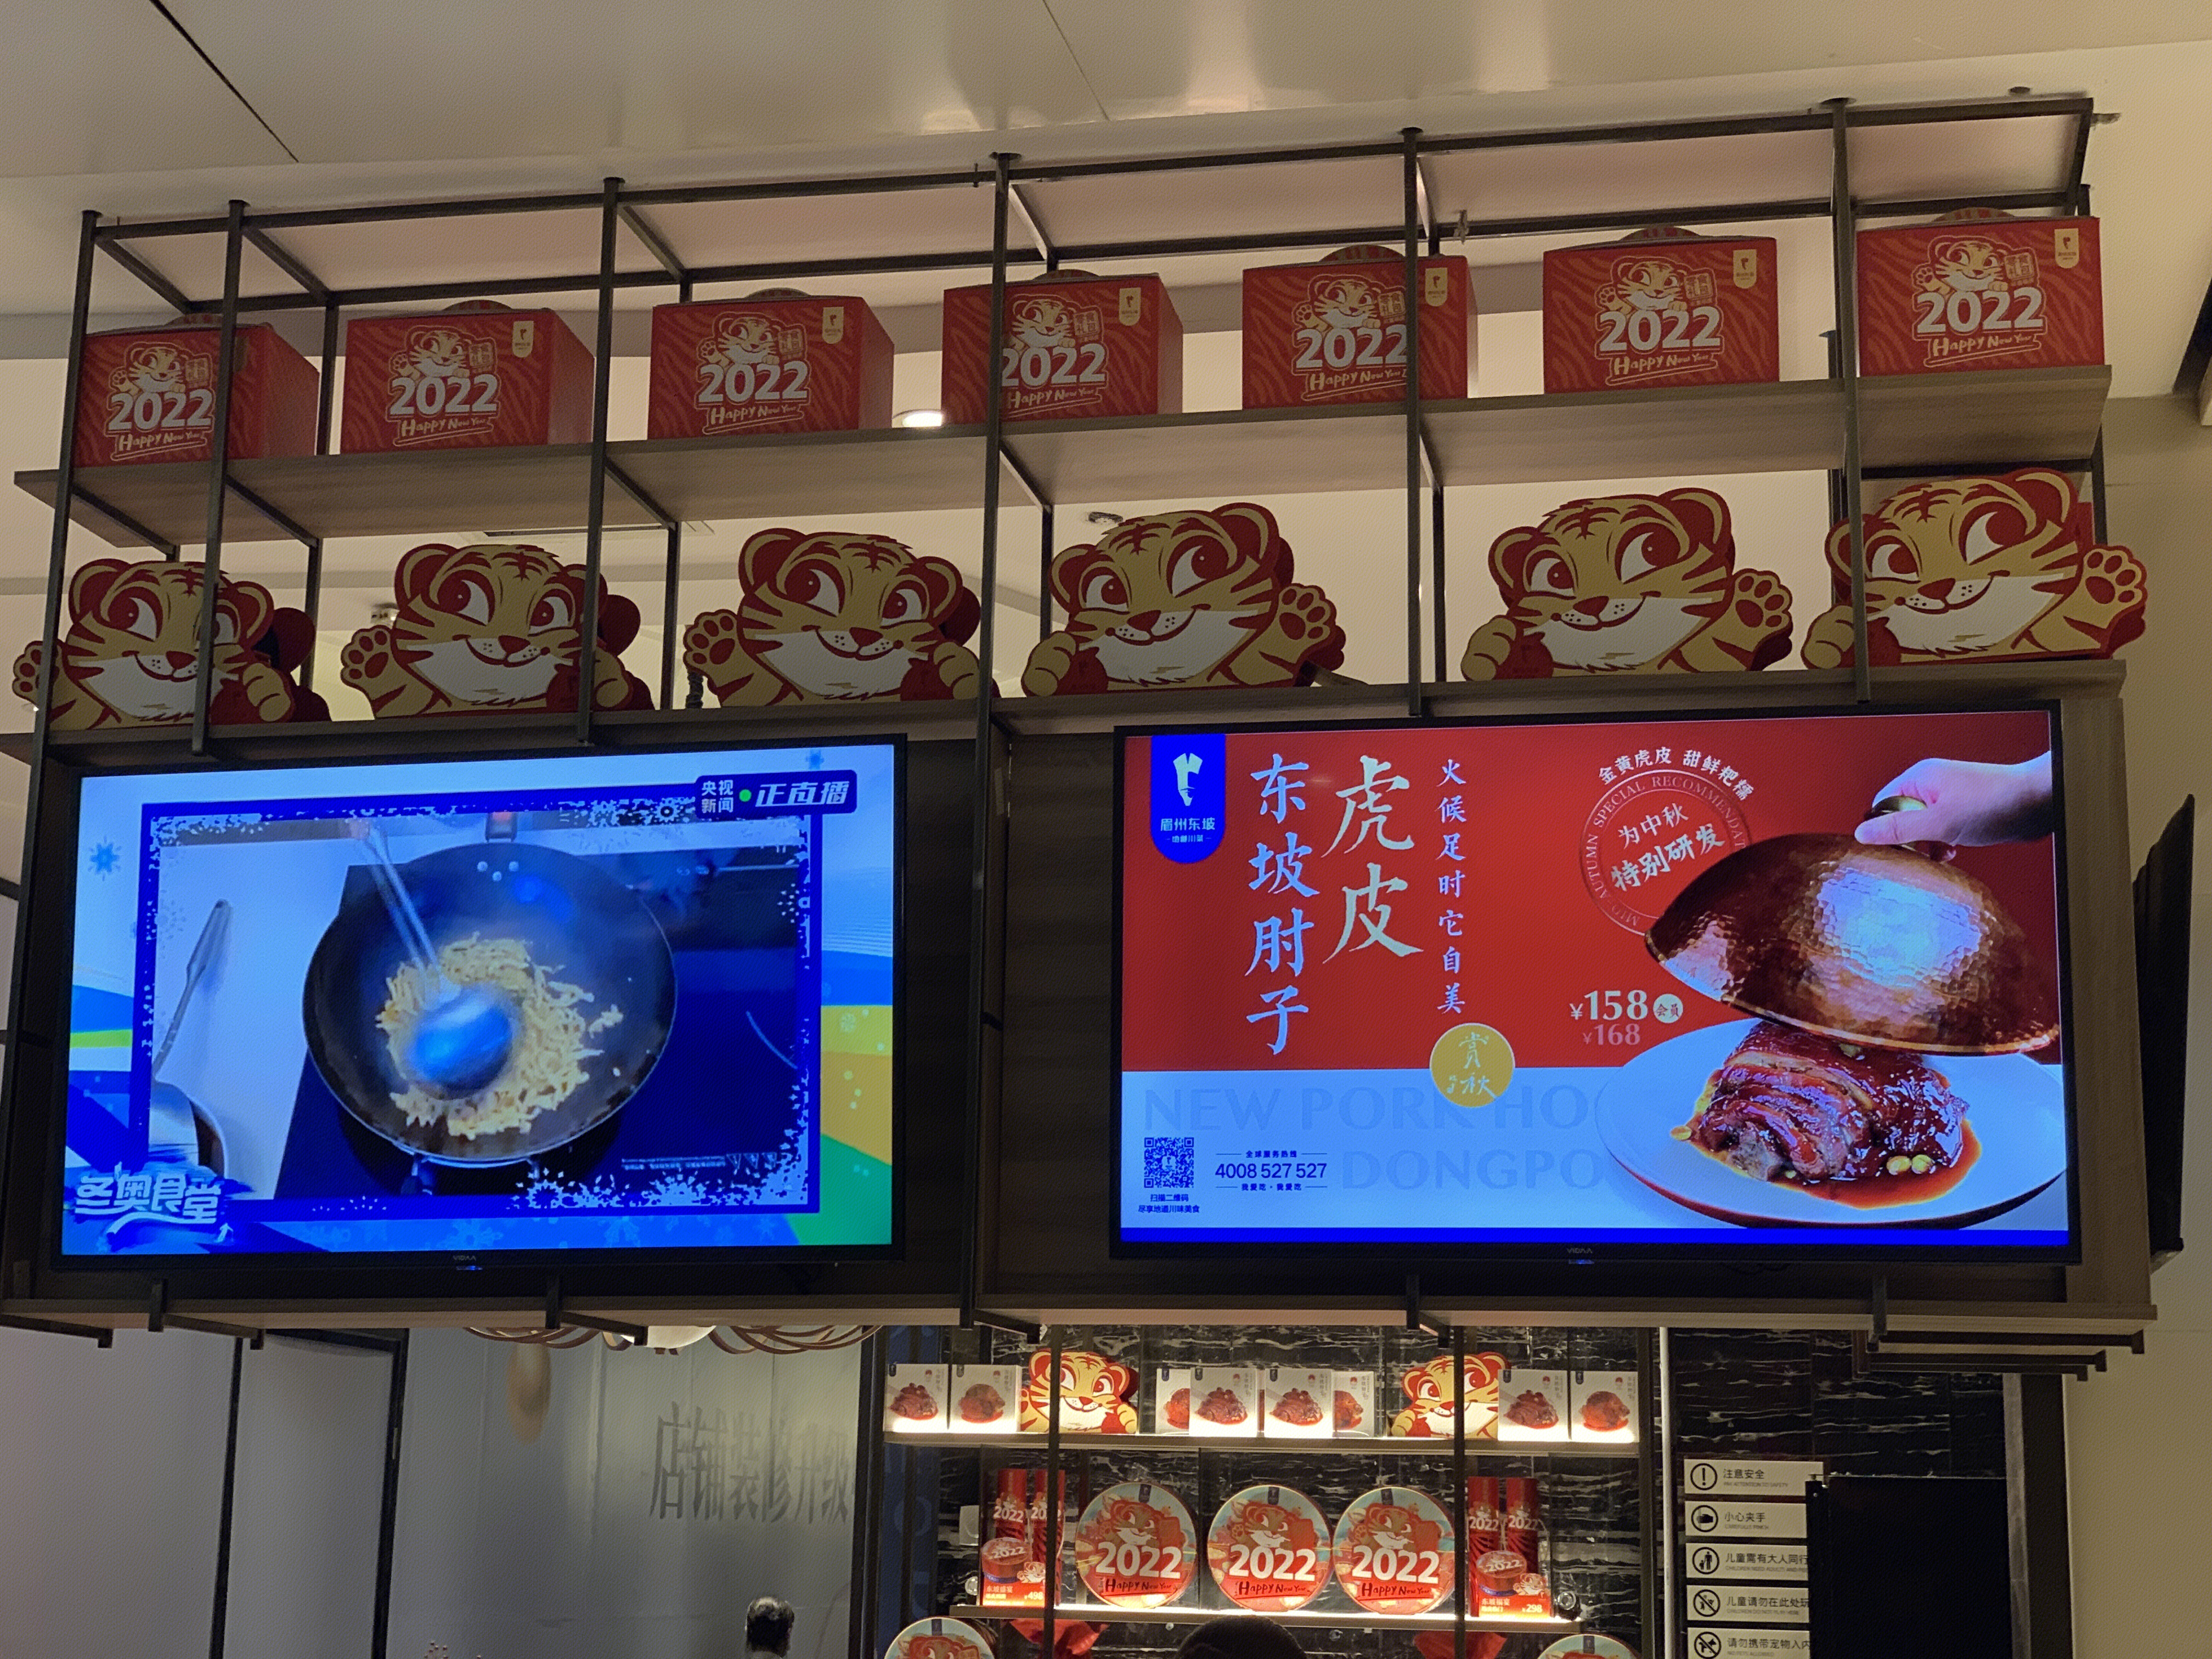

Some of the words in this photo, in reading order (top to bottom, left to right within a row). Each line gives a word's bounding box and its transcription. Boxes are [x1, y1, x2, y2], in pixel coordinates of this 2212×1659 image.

[1917, 287, 2043, 333] 2022
[1599, 306, 1720, 351] 2022
[1296, 324, 1407, 368] 2022
[1002, 343, 1105, 386] 2022
[390, 374, 498, 415] 2022
[698, 360, 808, 402] 2022
[108, 388, 212, 430] 2022
[702, 780, 733, 795] 央视
[1599, 747, 1672, 785] 金黄虎皮
[1683, 749, 1754, 800] 甜鲜粑糯
[702, 797, 733, 813] 新闻
[755, 781, 849, 807] 正直播
[1593, 781, 1645, 828] SPECIAL
[1160, 817, 1215, 831] 眉州东坡
[1618, 803, 1689, 850] 为中秋
[1321, 755, 1423, 963] 虎皮
[1611, 823, 1725, 891] 特别研发
[1437, 759, 1466, 1014] 火候足时它自美
[1245, 753, 1319, 1054] 东坡肘子
[1569, 990, 1648, 1020] ¥158
[1655, 1003, 1679, 1018] 会员
[1583, 1023, 1641, 1045] ¥168
[1144, 1088, 1281, 1131] NEW
[1245, 1150, 1297, 1159] 全球服务热线
[1215, 1163, 1257, 1178] 4008
[1261, 1163, 1292, 1178] 527
[1296, 1163, 1327, 1178] 527
[1150, 1194, 1189, 1202] 扫描二维码
[1723, 1469, 1765, 1480] 注意安全
[994, 1506, 1024, 1523] 2022
[1469, 1516, 1499, 1531] 2022
[1724, 1512, 1766, 1522] 小心夹手
[991, 1547, 1026, 1559] 2022
[1096, 1542, 1182, 1579] 2022
[1229, 1544, 1316, 1582] 2022
[1352, 1545, 1440, 1584] 2022
[1485, 1560, 1522, 1573] 2022
[1726, 1553, 1808, 1564] 儿童需有大人同行
[1105, 1578, 1139, 1592] Happy
[1239, 1581, 1274, 1595] Happy
[1362, 1583, 1397, 1596] Happy
